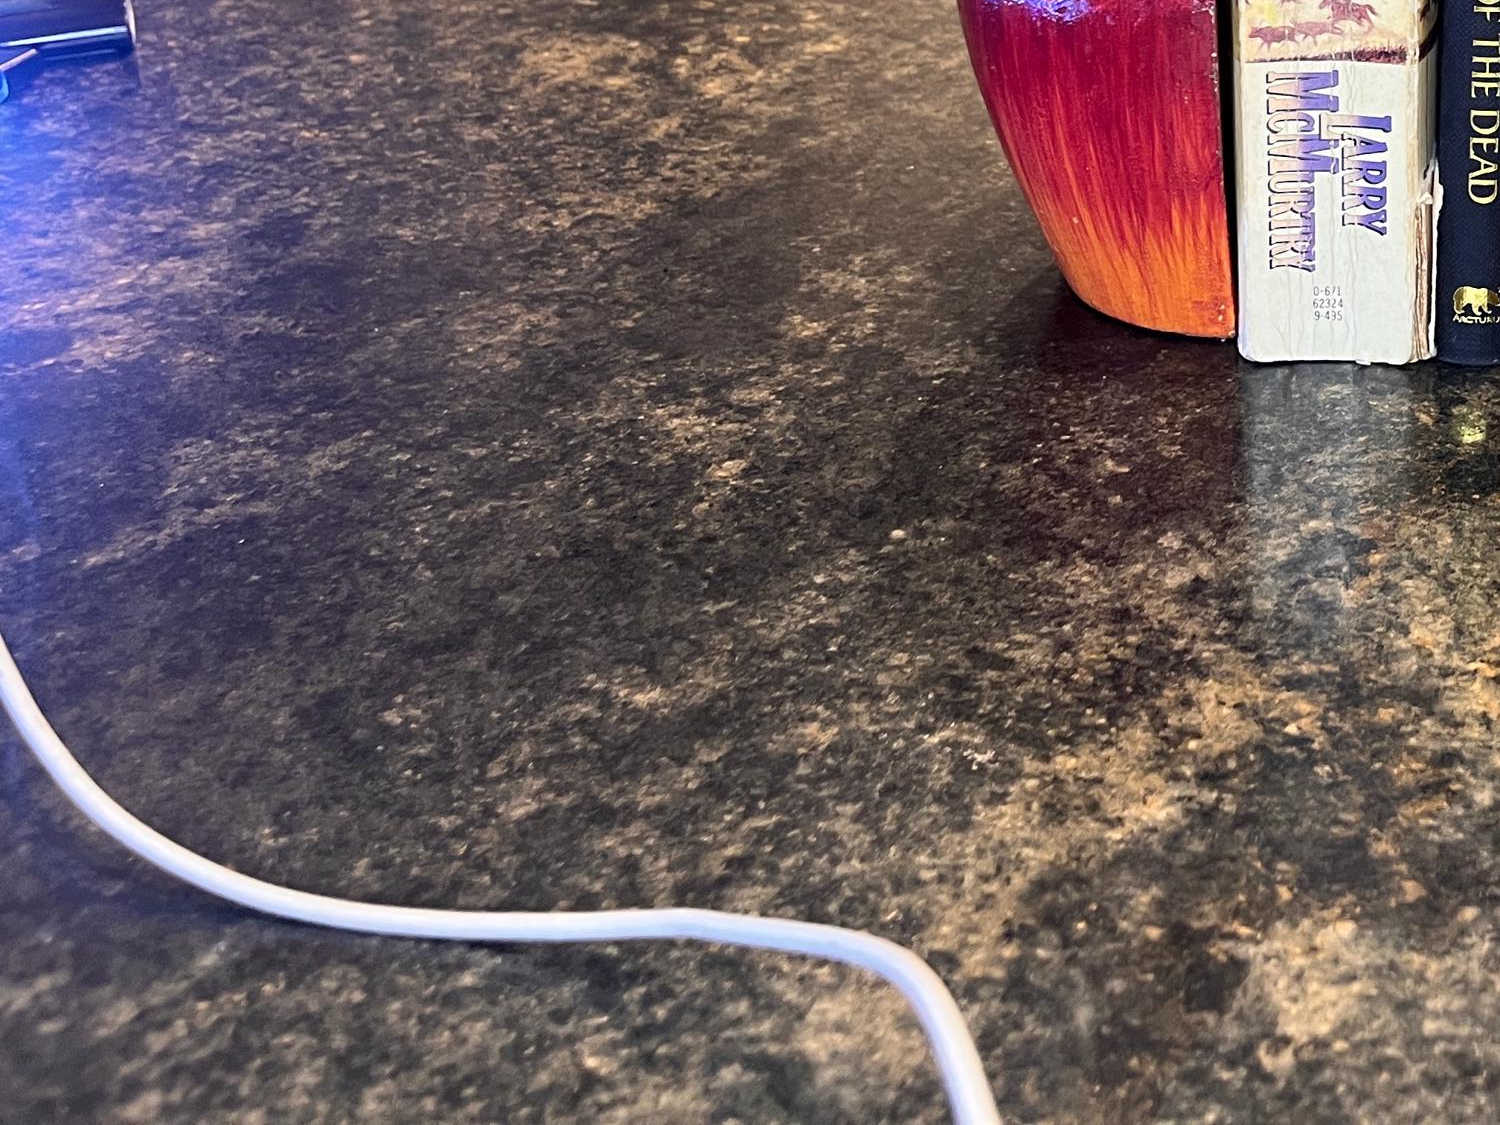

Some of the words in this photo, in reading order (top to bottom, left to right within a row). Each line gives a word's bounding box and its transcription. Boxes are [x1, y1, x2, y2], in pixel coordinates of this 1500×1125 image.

[1319, 112, 1392, 236] LARRY
[1467, 109, 1500, 204] DEAD
[1312, 298, 1343, 309] 62324
